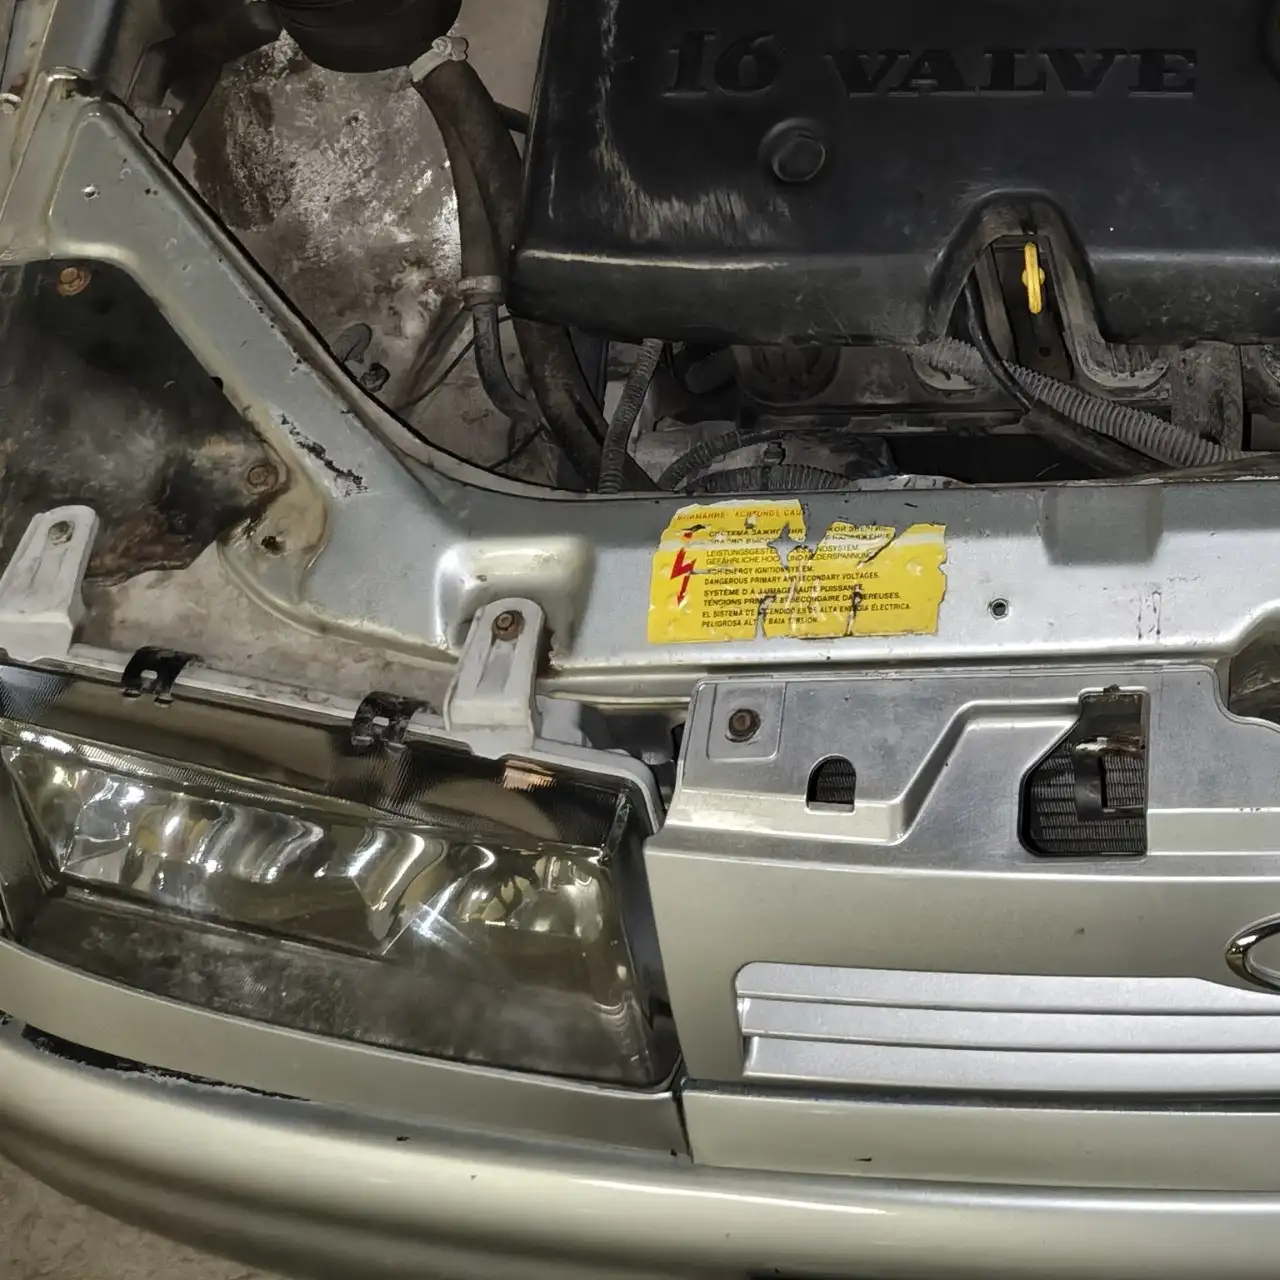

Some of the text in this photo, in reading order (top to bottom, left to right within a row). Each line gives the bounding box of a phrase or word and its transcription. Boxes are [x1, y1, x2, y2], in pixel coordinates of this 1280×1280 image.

[663, 29, 1198, 98] 16 VALVE
[705, 577, 748, 585] DANGEROUS
[750, 575, 781, 583] PRIMARY
[713, 608, 743, 618] SISTEMA
[746, 608, 755, 616] DE
[820, 604, 838, 613] ALTA
[702, 619, 741, 628] PELIGROSA
